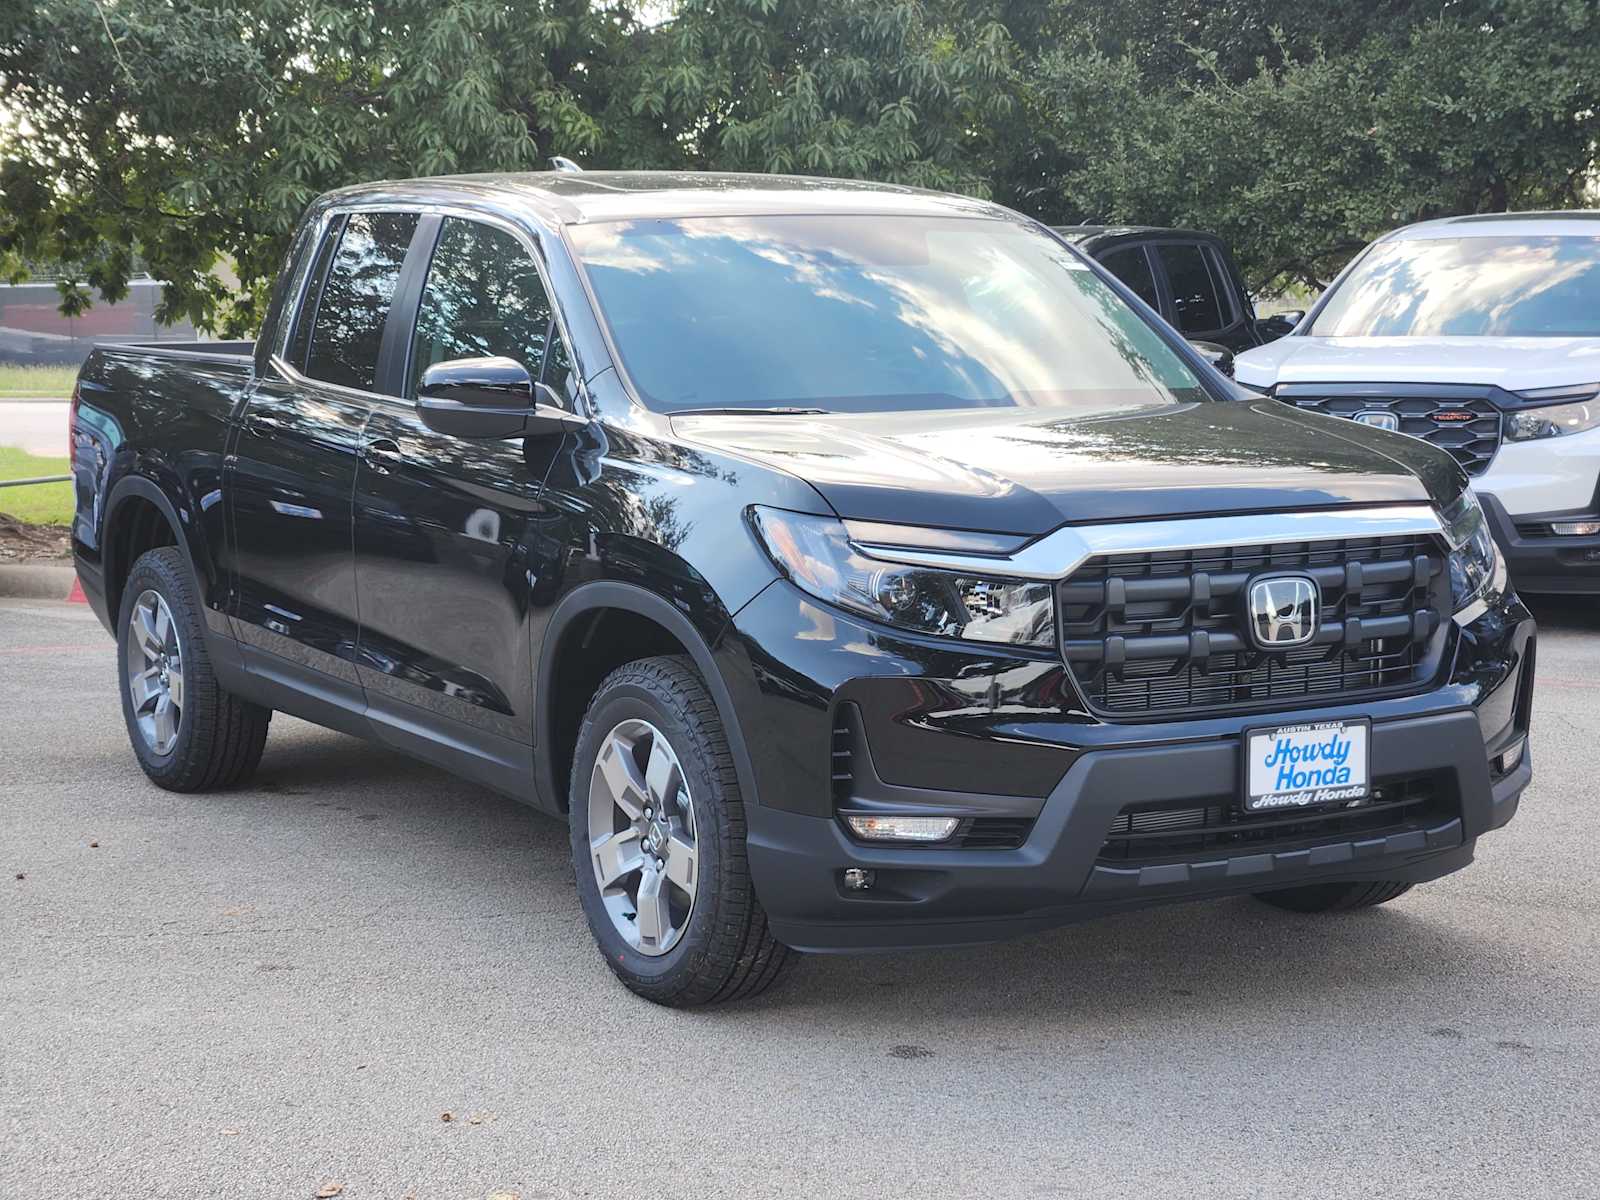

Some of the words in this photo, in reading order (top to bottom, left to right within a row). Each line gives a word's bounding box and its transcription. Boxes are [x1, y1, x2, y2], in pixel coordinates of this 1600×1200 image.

[1276, 725, 1311, 735] AUSTIN
[1314, 721, 1344, 731] TEXAS
[1264, 734, 1351, 768] Howdy
[1275, 766, 1351, 790] Honda
[1252, 791, 1312, 808] Howdy
[1314, 785, 1366, 801] Honda
